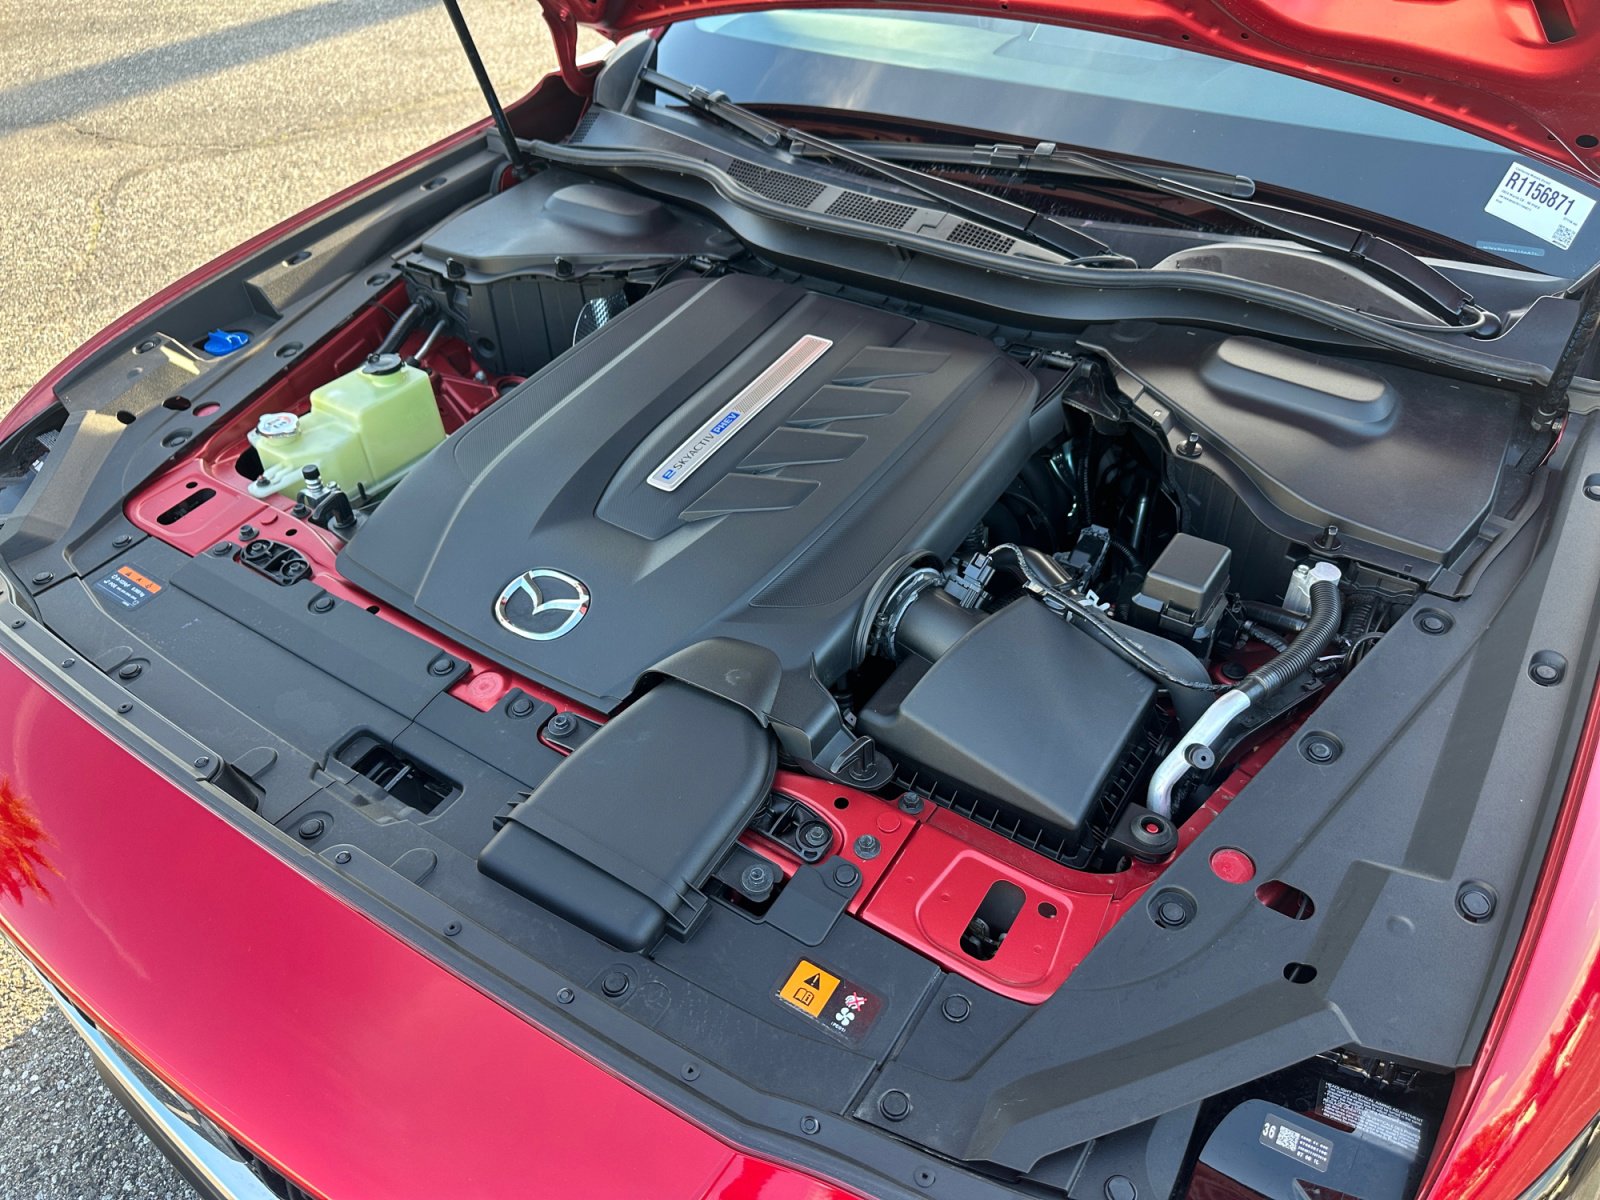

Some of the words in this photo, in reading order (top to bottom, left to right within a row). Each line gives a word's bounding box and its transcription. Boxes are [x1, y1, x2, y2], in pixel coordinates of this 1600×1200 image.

[1505, 171, 1576, 216] R1156871
[712, 411, 739, 434] PHEV
[1262, 1122, 1277, 1139] 36
